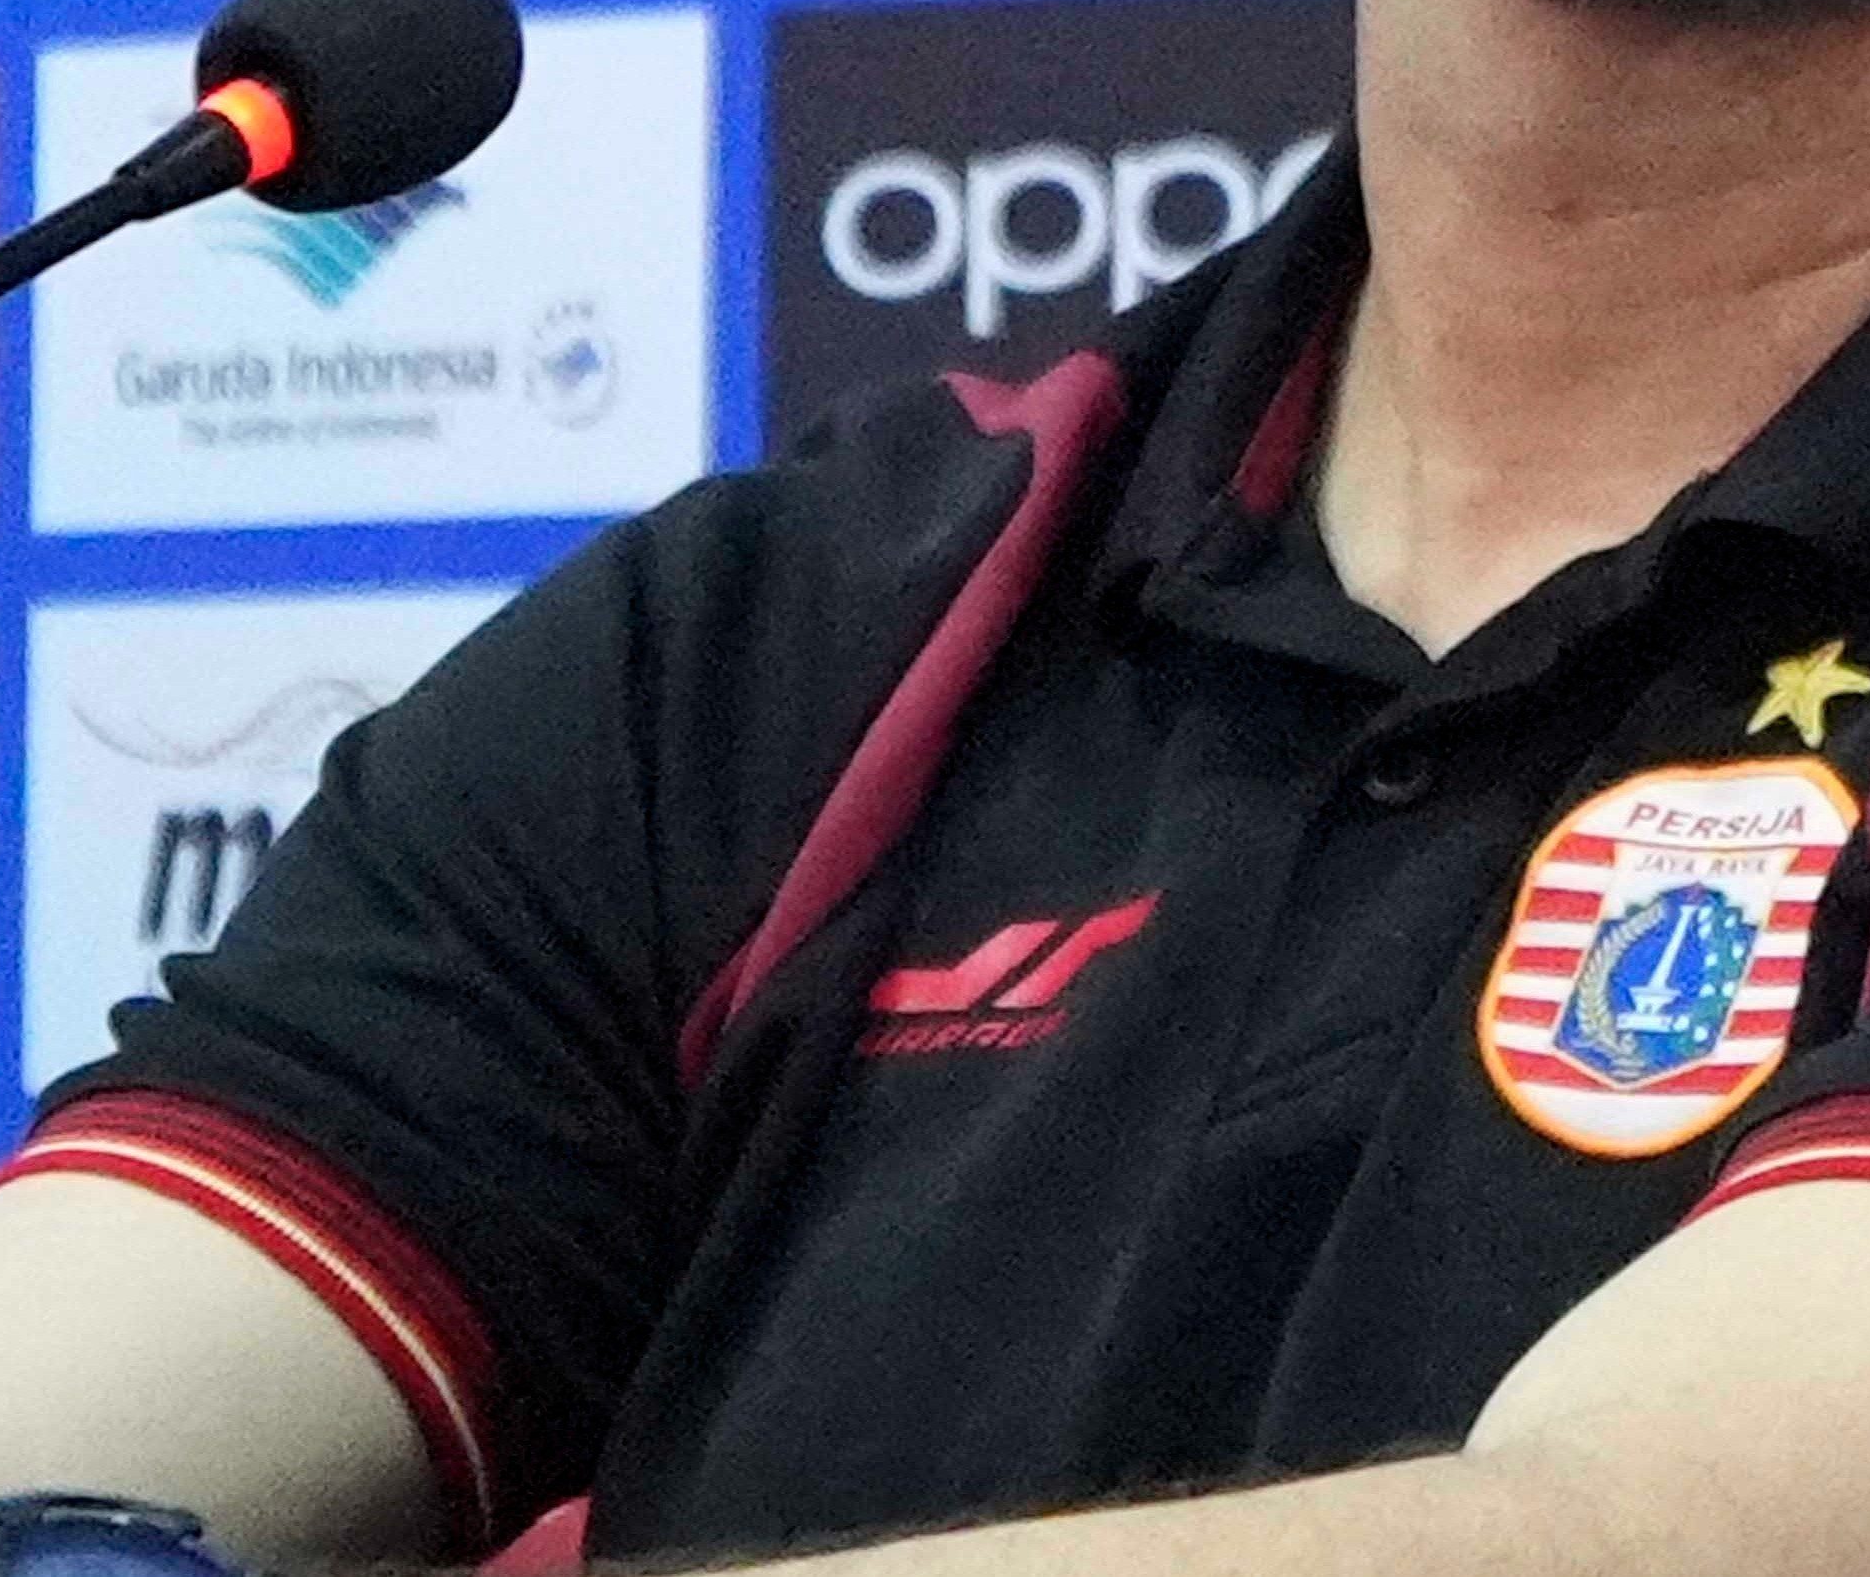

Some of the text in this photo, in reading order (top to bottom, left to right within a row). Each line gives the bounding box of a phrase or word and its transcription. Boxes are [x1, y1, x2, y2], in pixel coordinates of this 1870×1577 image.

[114, 347, 273, 407] Garuda
[285, 341, 498, 401] Indonesia
[1625, 801, 1807, 840] PERSIJA
